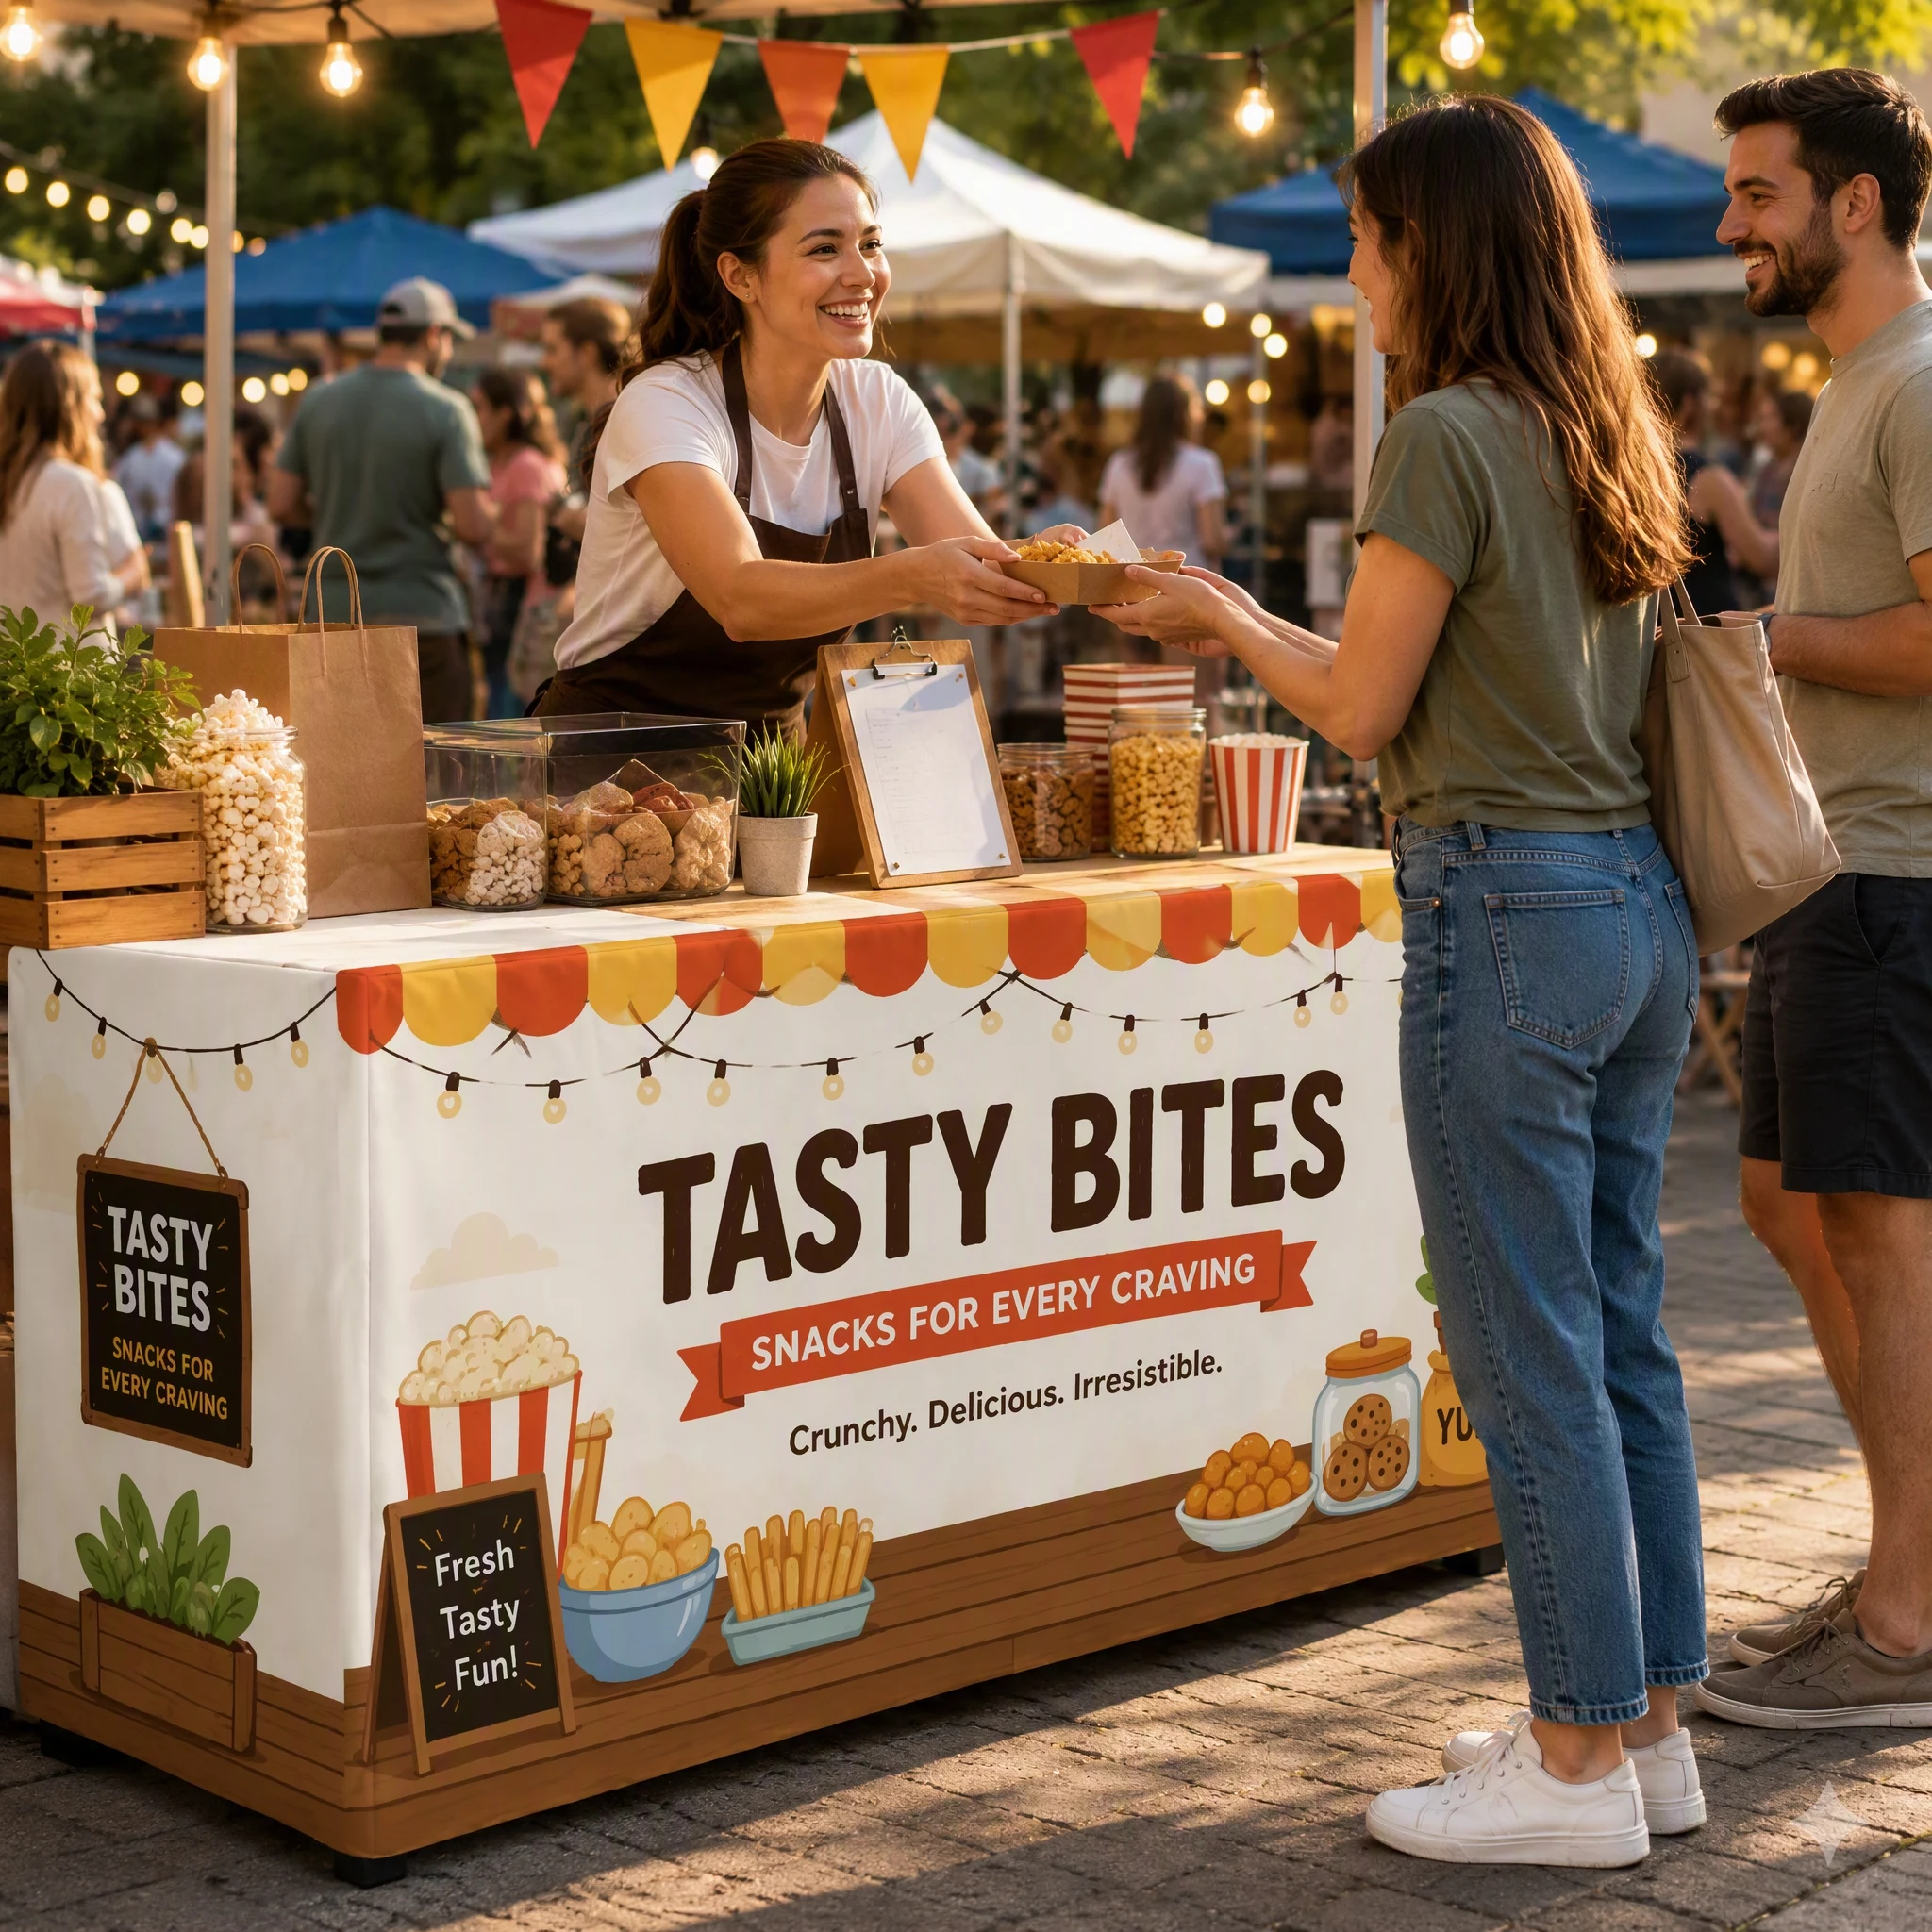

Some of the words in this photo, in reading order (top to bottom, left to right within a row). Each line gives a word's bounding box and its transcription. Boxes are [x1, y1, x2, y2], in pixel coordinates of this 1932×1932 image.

[638, 1103, 1013, 1304] TASTY
[1051, 1070, 1345, 1232] BITES
[108, 1206, 213, 1270] TASTY
[114, 1264, 211, 1332] BITES
[752, 1312, 896, 1371] SNACKS
[909, 1297, 979, 1340] FOR
[992, 1276, 1100, 1324] EVERY
[1111, 1253, 1256, 1304] CRAVING
[112, 1336, 176, 1373] SNACKS
[182, 1354, 213, 1381] FOR
[101, 1367, 151, 1399] EVERY
[156, 1381, 227, 1420] CRAVING
[789, 1409, 918, 1456] Crunchy.
[928, 1383, 1064, 1428] Delicious.
[1074, 1349, 1223, 1401] Irresistible.
[1437, 1407, 1478, 1445] YU
[434, 1539, 514, 1587] Fresh
[440, 1599, 520, 1639] Tasty
[455, 1645, 518, 1690] Fun!
